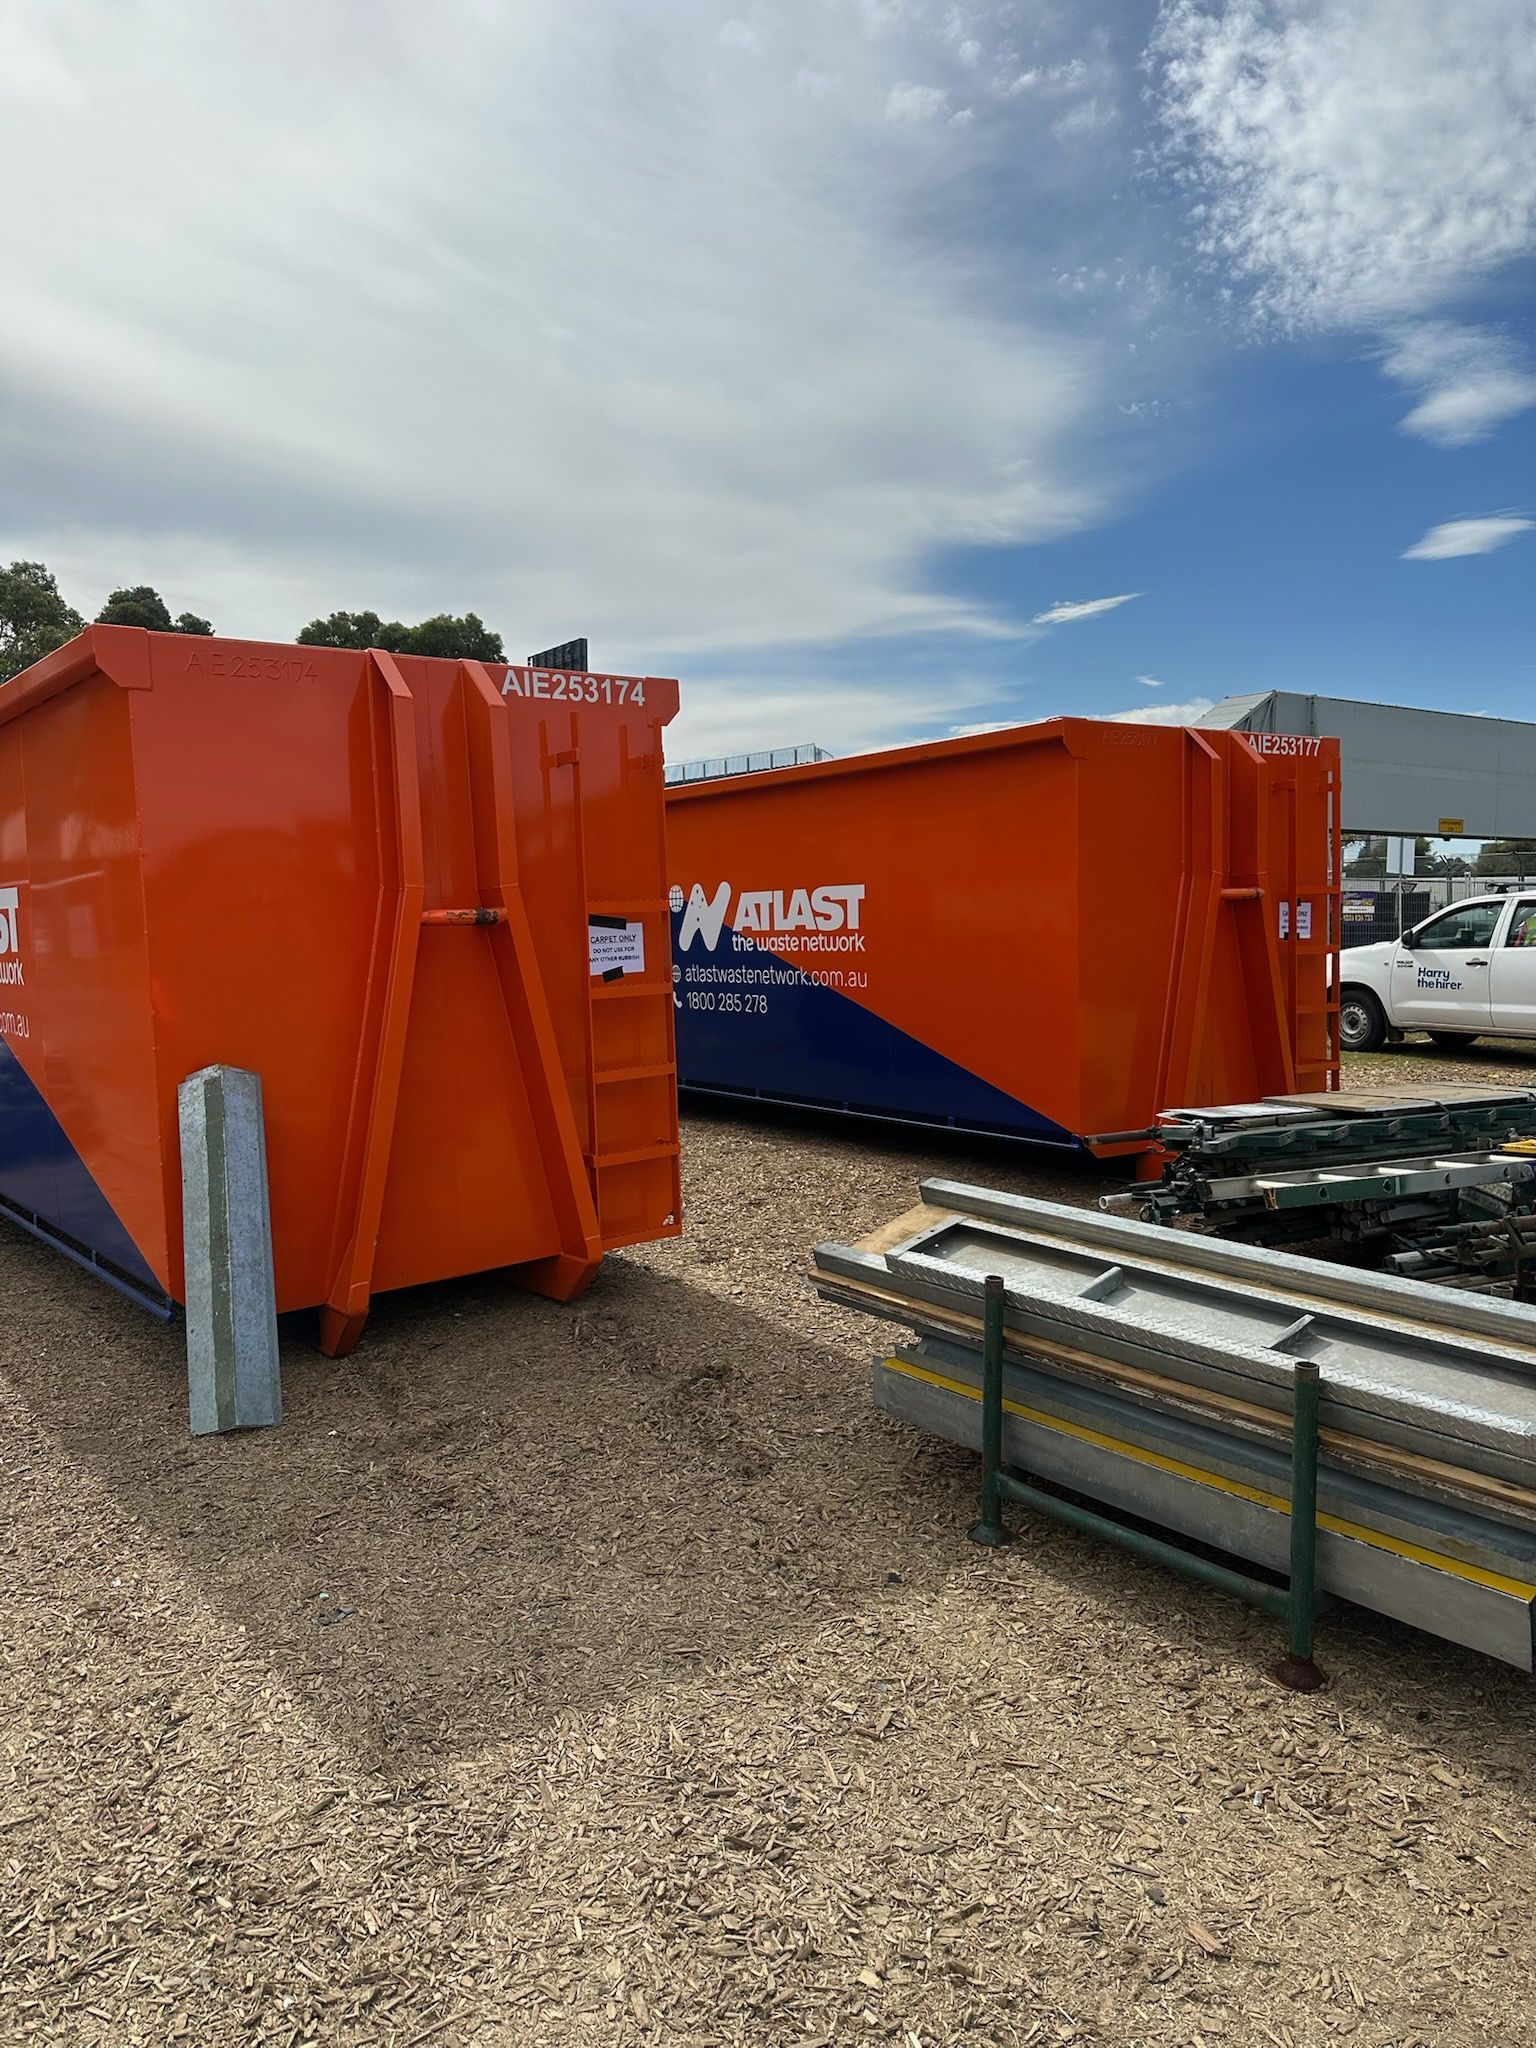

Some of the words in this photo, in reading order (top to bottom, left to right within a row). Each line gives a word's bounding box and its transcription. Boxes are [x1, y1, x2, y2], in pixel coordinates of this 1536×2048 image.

[501, 669, 646, 706] AIE253174
[1248, 734, 1321, 757] AIE253177
[732, 884, 865, 931] ATLAST
[619, 934, 636, 942] ONLY
[732, 934, 754, 952] the
[757, 935, 802, 952] waste
[804, 933, 866, 952] network
[685, 964, 868, 988] atlastwastenetwork.com.au
[1417, 978, 1435, 988] the
[1418, 967, 1450, 981] Harry
[686, 991, 716, 1011] 1800
[719, 993, 742, 1012] 285
[745, 994, 768, 1014] 278
